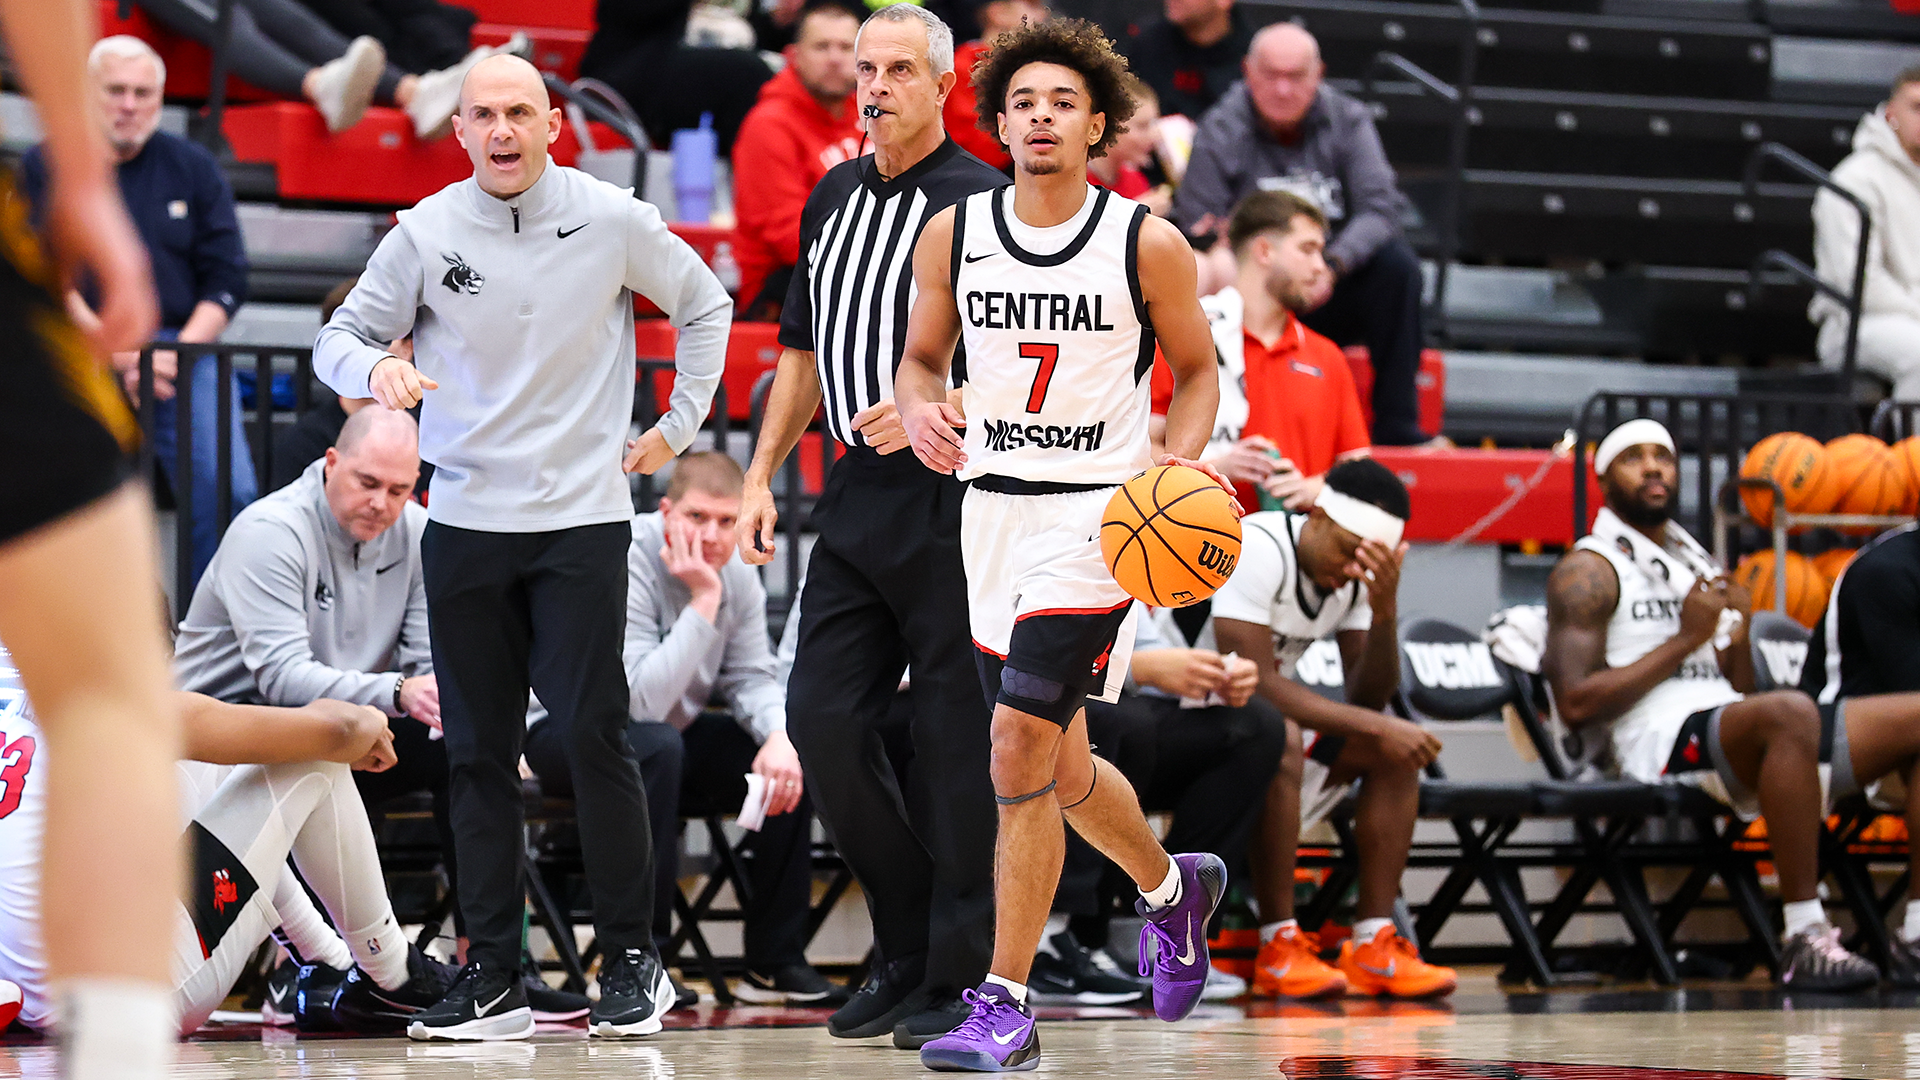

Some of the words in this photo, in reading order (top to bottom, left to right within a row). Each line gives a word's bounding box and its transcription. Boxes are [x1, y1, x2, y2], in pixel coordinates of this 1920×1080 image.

[966, 291, 1114, 331] CENTRAL
[1018, 342, 1059, 414] 7
[984, 418, 1106, 452] MISSOURI
[1296, 639, 1345, 688] UC
[1403, 641, 1503, 688] UCM
[0, 731, 36, 819] 3
